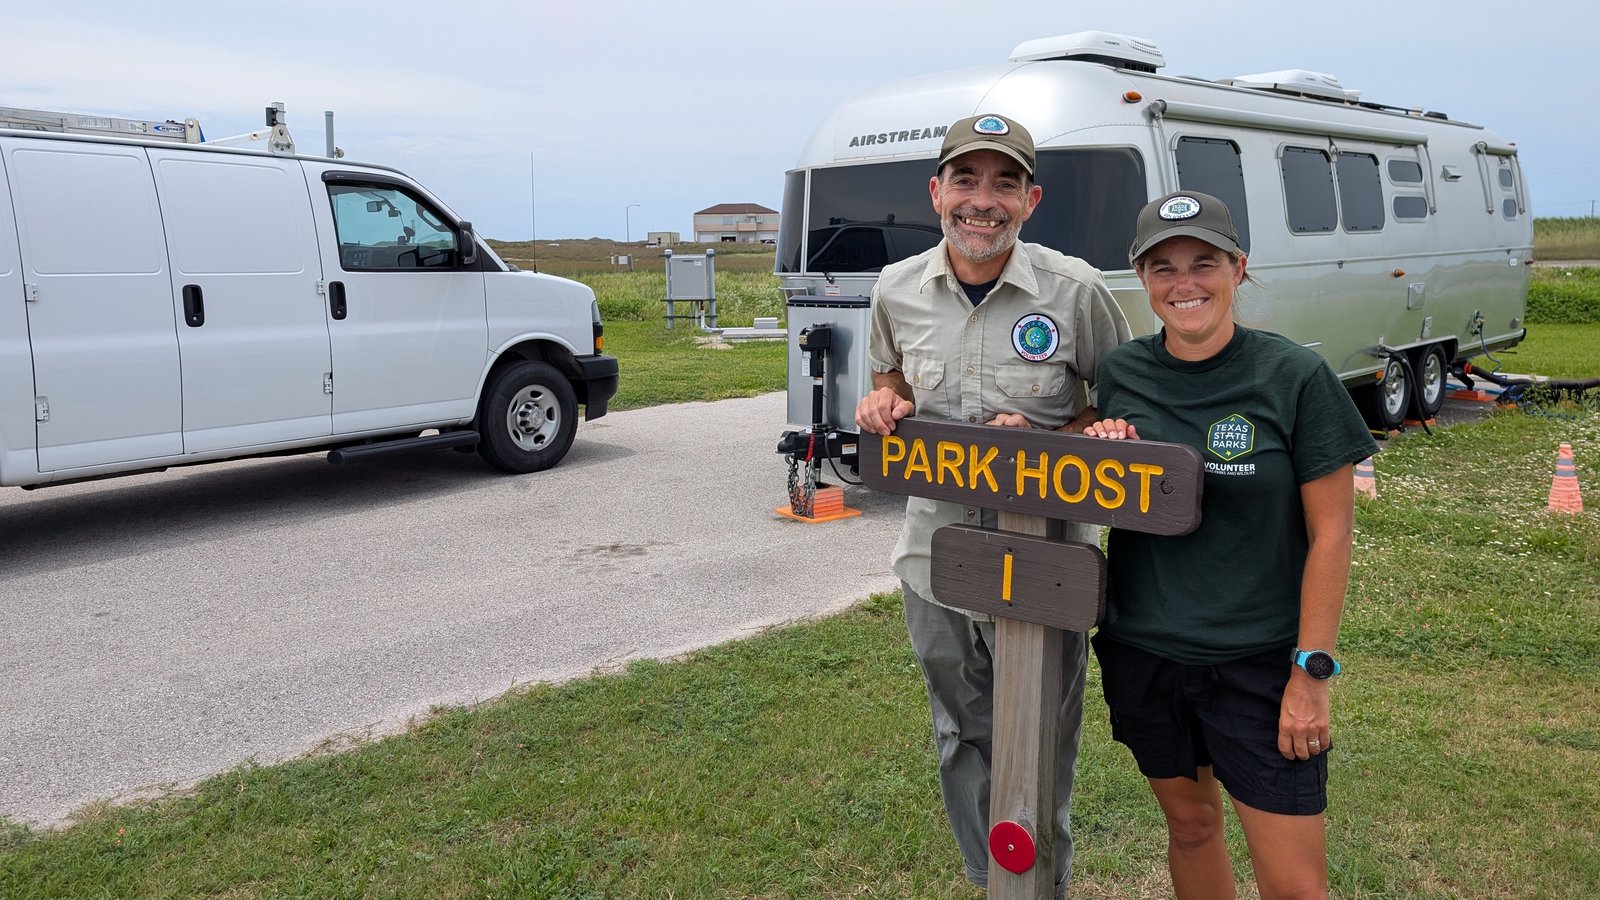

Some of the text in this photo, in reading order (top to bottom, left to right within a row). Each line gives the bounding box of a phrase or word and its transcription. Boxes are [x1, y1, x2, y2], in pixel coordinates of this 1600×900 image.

[849, 126, 947, 147] AIRSTREAM
[1021, 350, 1048, 360] VOLUNTEER
[1216, 424, 1249, 433] TEXAS
[1213, 432, 1248, 441] STATE
[1212, 440, 1247, 449] PARKS
[1204, 461, 1256, 472] VOLUNTEER
[881, 435, 1164, 513] PARK HOST
